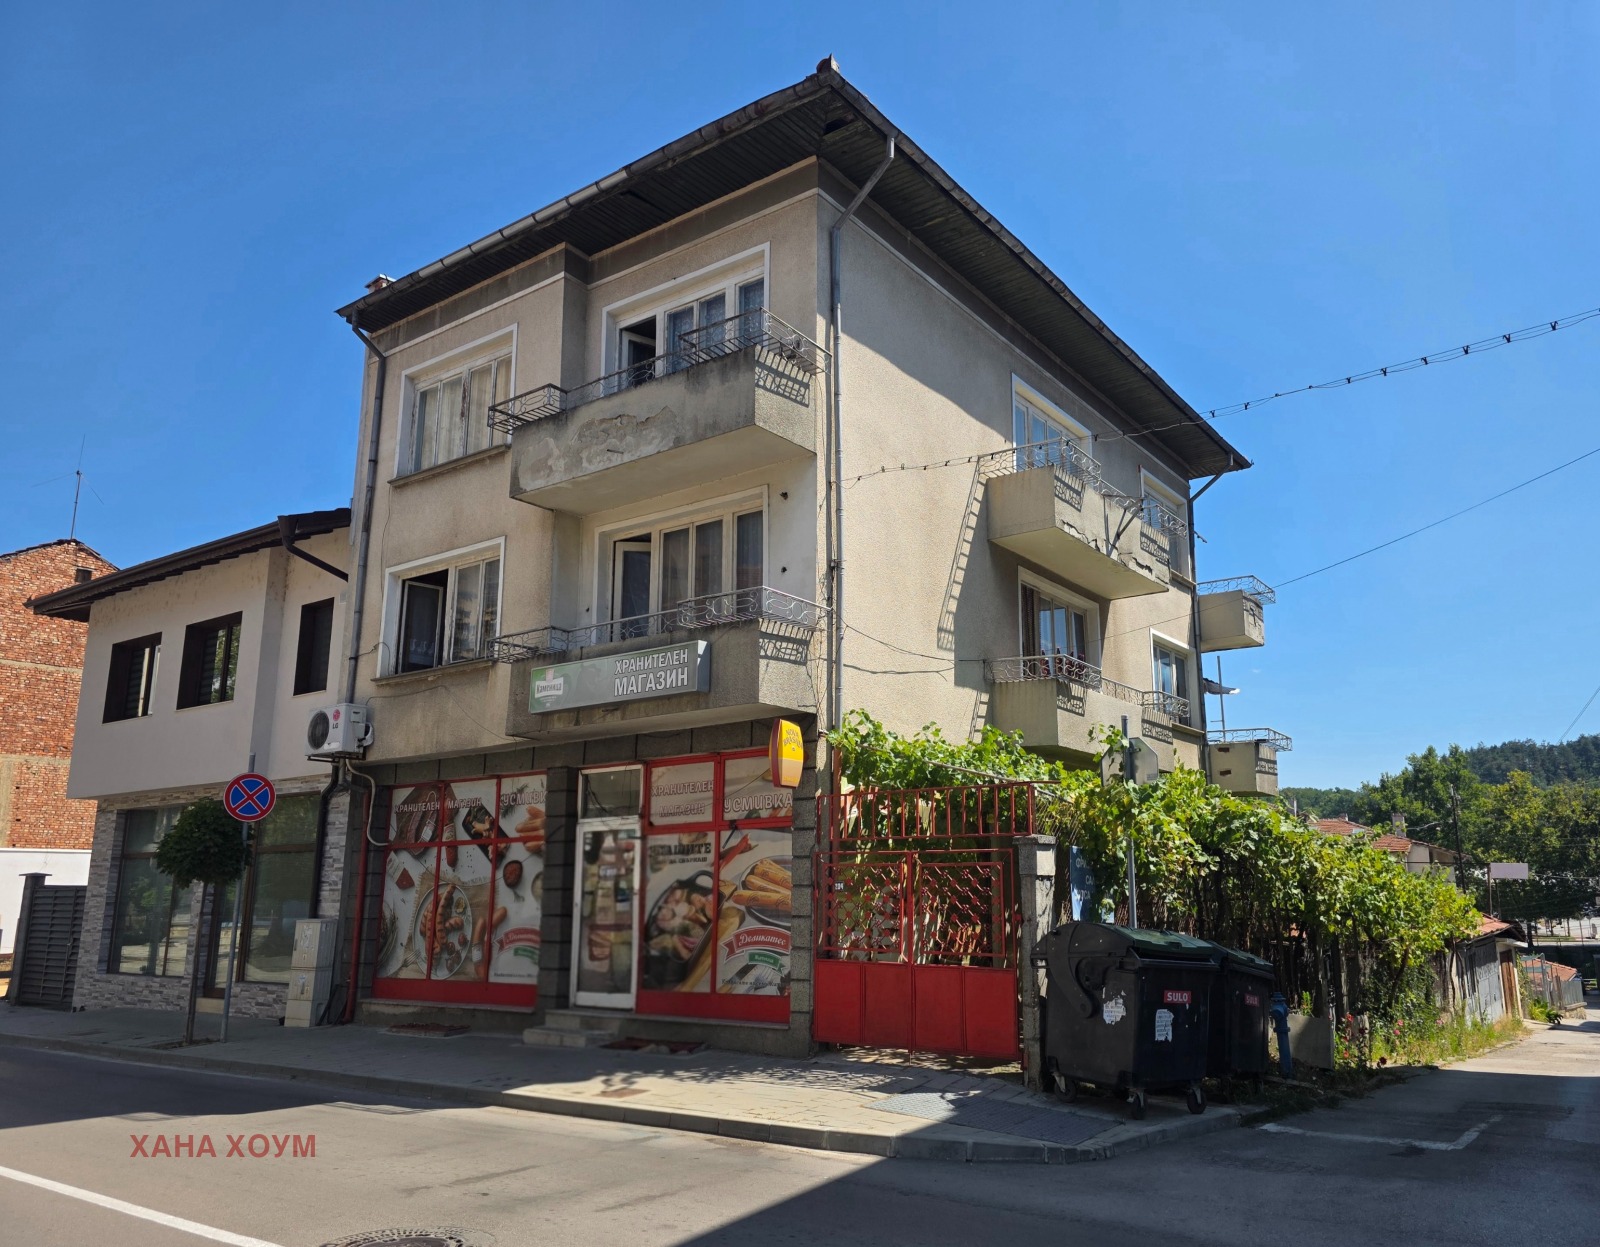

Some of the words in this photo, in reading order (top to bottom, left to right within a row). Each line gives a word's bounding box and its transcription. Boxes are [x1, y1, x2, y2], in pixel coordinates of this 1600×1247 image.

[614, 648, 688, 675] ХРАНИТЕЛЕН
[614, 667, 688, 696] МАГАЗИН
[332, 722, 339, 730] LG
[651, 780, 714, 797] ХРАНИТЕЛЕН
[394, 801, 440, 815] ХРАНИТЕЛЕН
[447, 797, 482, 810] МАГАЗИН
[658, 803, 705, 818] МАГАЗИН
[724, 793, 793, 813] УСМИВКА
[738, 932, 787, 947] Деликатес
[1167, 992, 1188, 1002] SULO
[1246, 995, 1258, 1005] SULO
